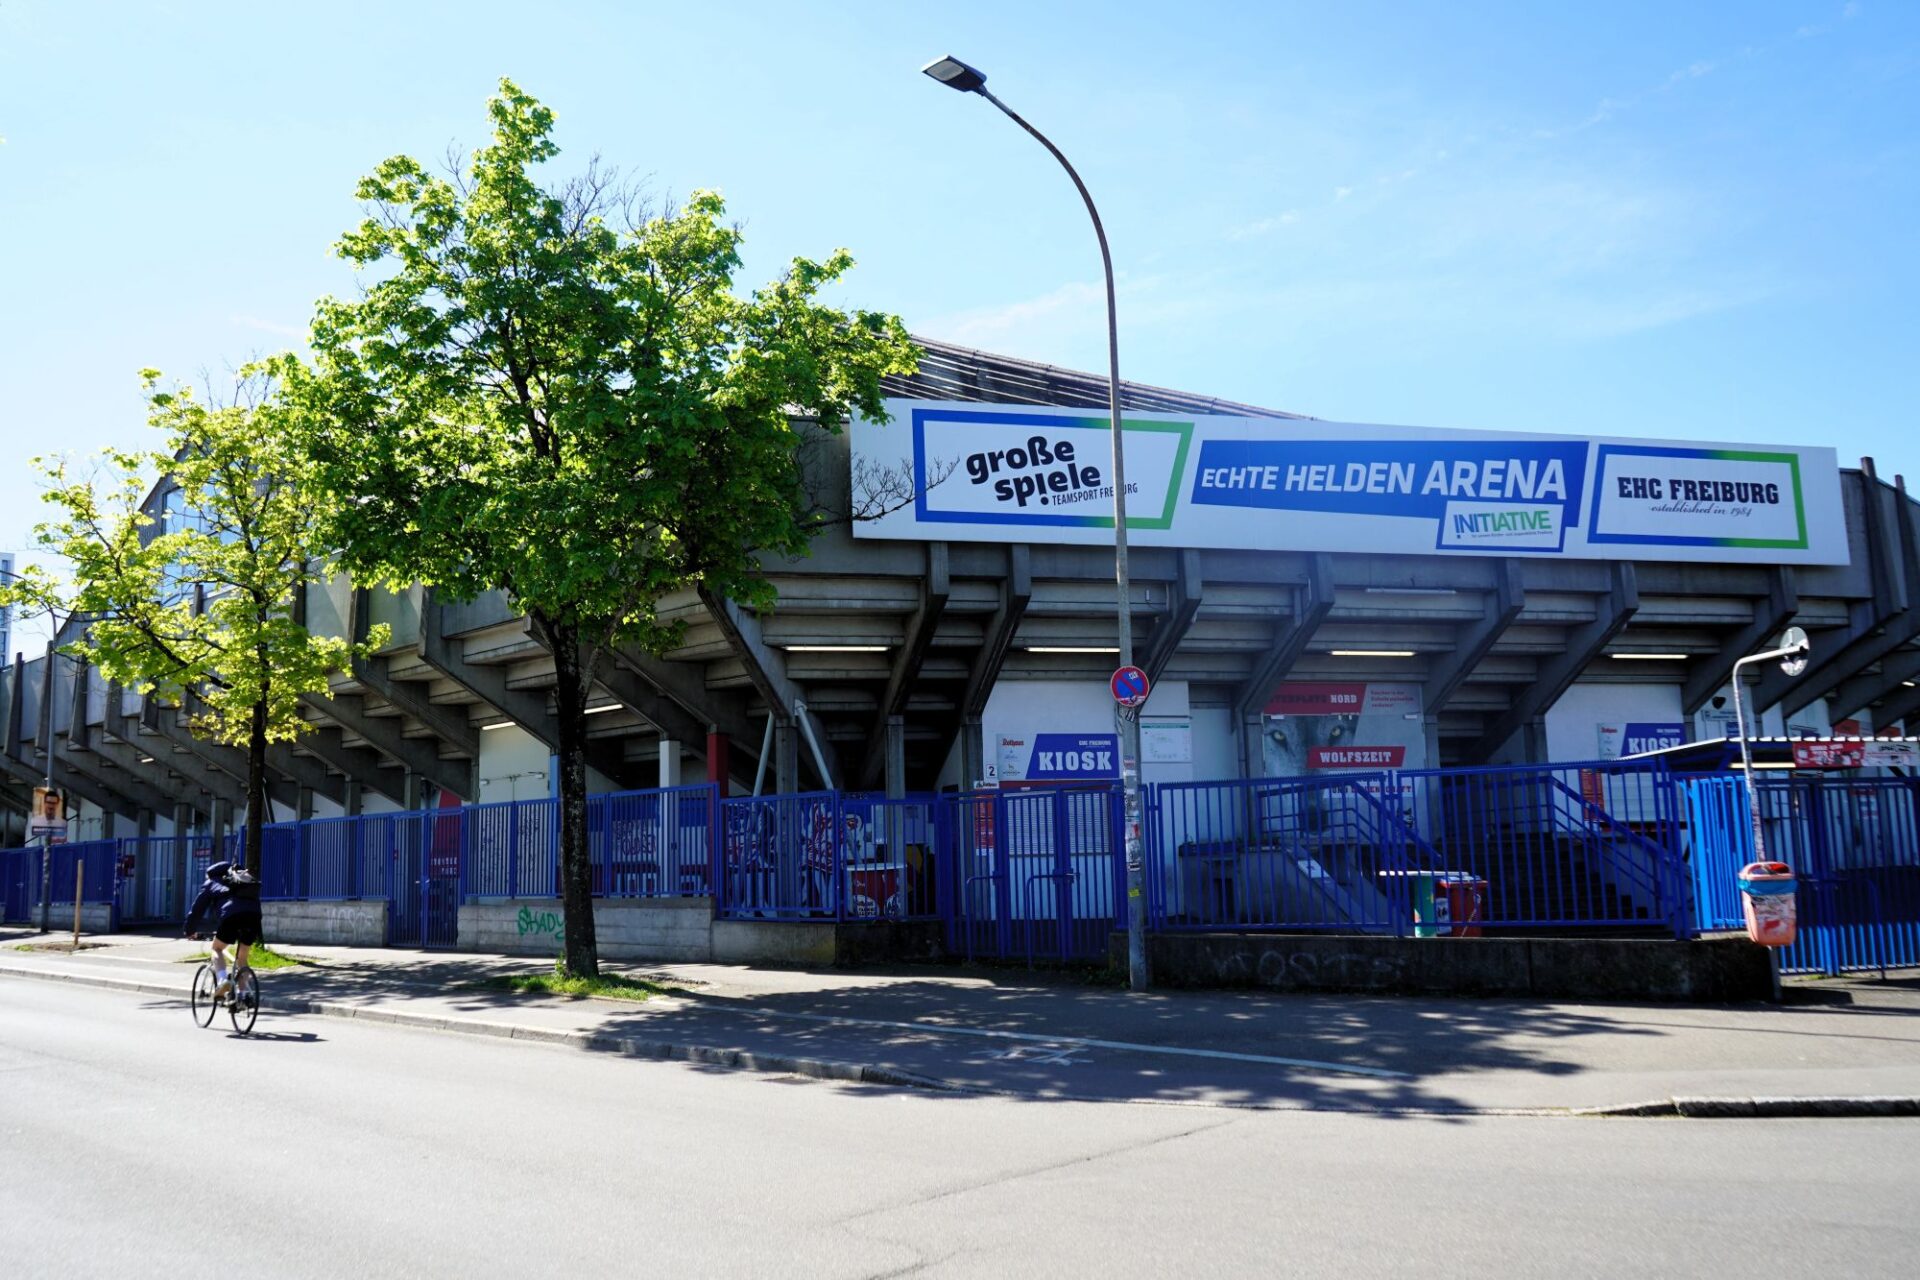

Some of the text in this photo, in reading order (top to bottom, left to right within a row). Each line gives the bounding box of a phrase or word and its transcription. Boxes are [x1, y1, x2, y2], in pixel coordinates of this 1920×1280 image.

[966, 436, 1075, 485] große
[1201, 458, 1567, 500] ECHTE HELDEN ARENA
[1052, 489, 1098, 506] TEAMSPORT
[1617, 476, 1779, 504] EHC FREIBURG
[1651, 500, 1712, 515] established
[1713, 504, 1726, 515] in
[1330, 694, 1357, 704] NORD
[1628, 737, 1681, 753] KIOSK
[1039, 751, 1112, 771] KIOSK
[1320, 751, 1392, 763] WOLFSZEIT
[989, 766, 995, 776] 2
